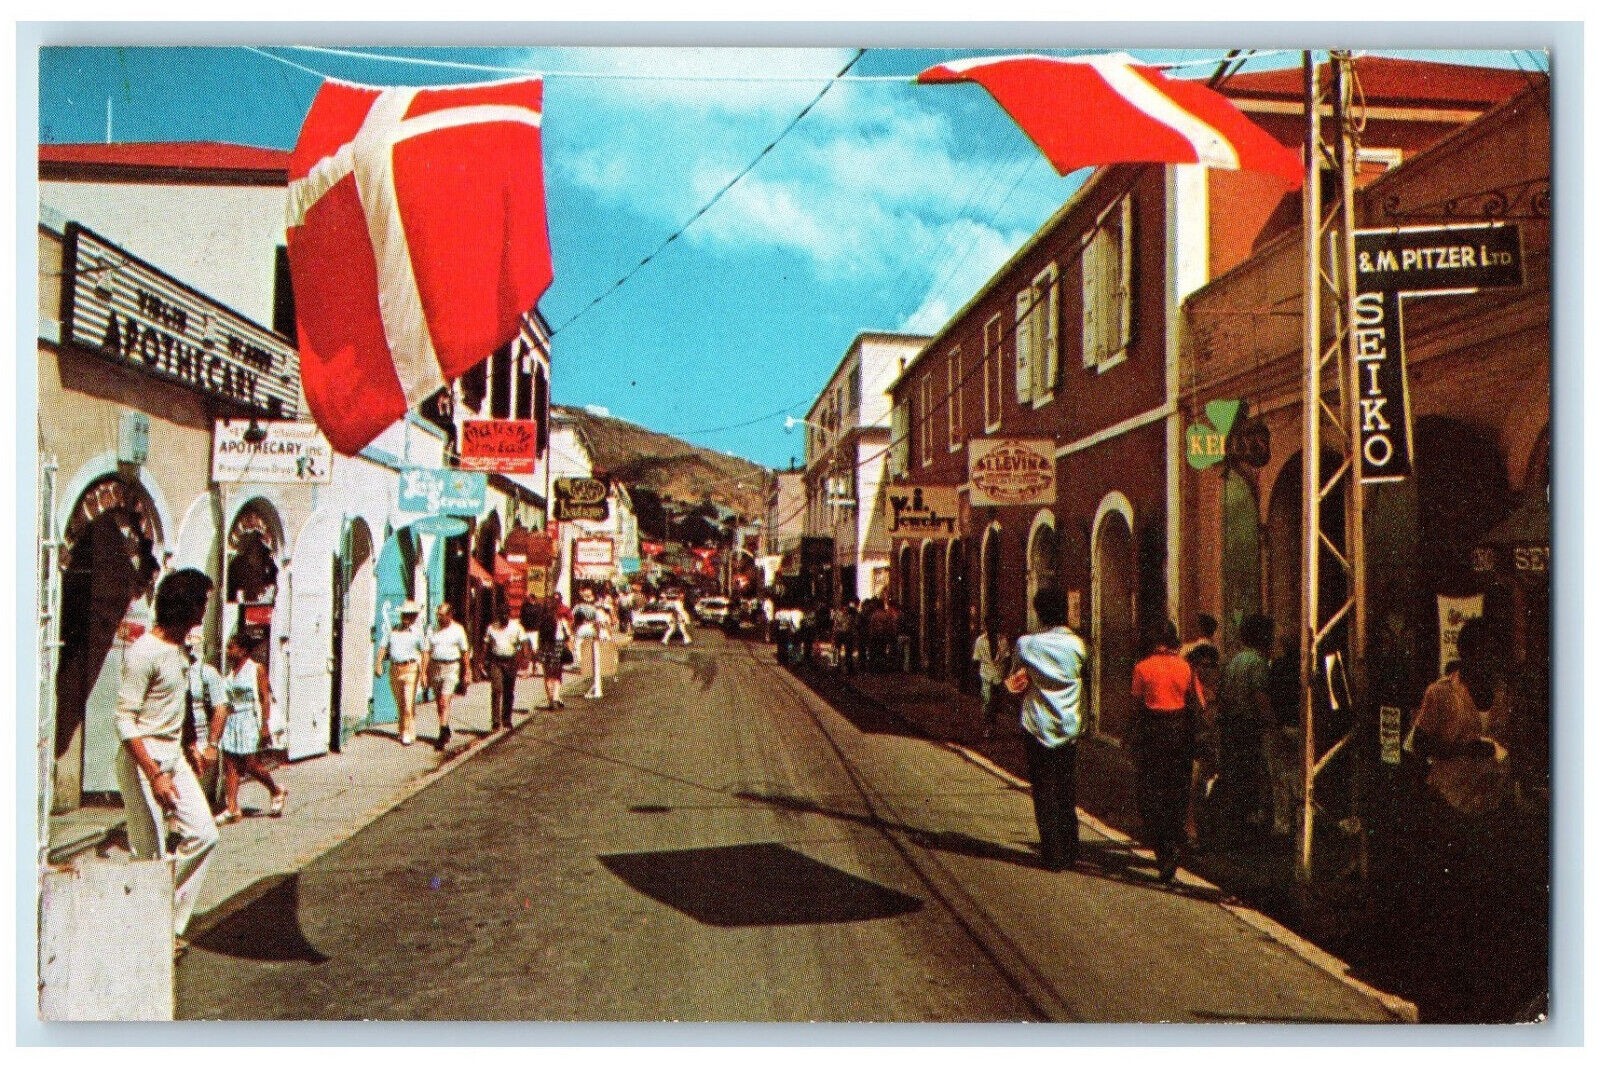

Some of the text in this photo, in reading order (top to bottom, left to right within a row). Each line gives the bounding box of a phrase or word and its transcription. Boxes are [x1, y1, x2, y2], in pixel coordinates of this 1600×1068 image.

[1358, 249, 1375, 272] &
[1402, 245, 1478, 271] PITZER
[1351, 291, 1394, 467] SEIKO
[219, 440, 302, 456] APOTHECARY
[1514, 546, 1550, 571] SE
